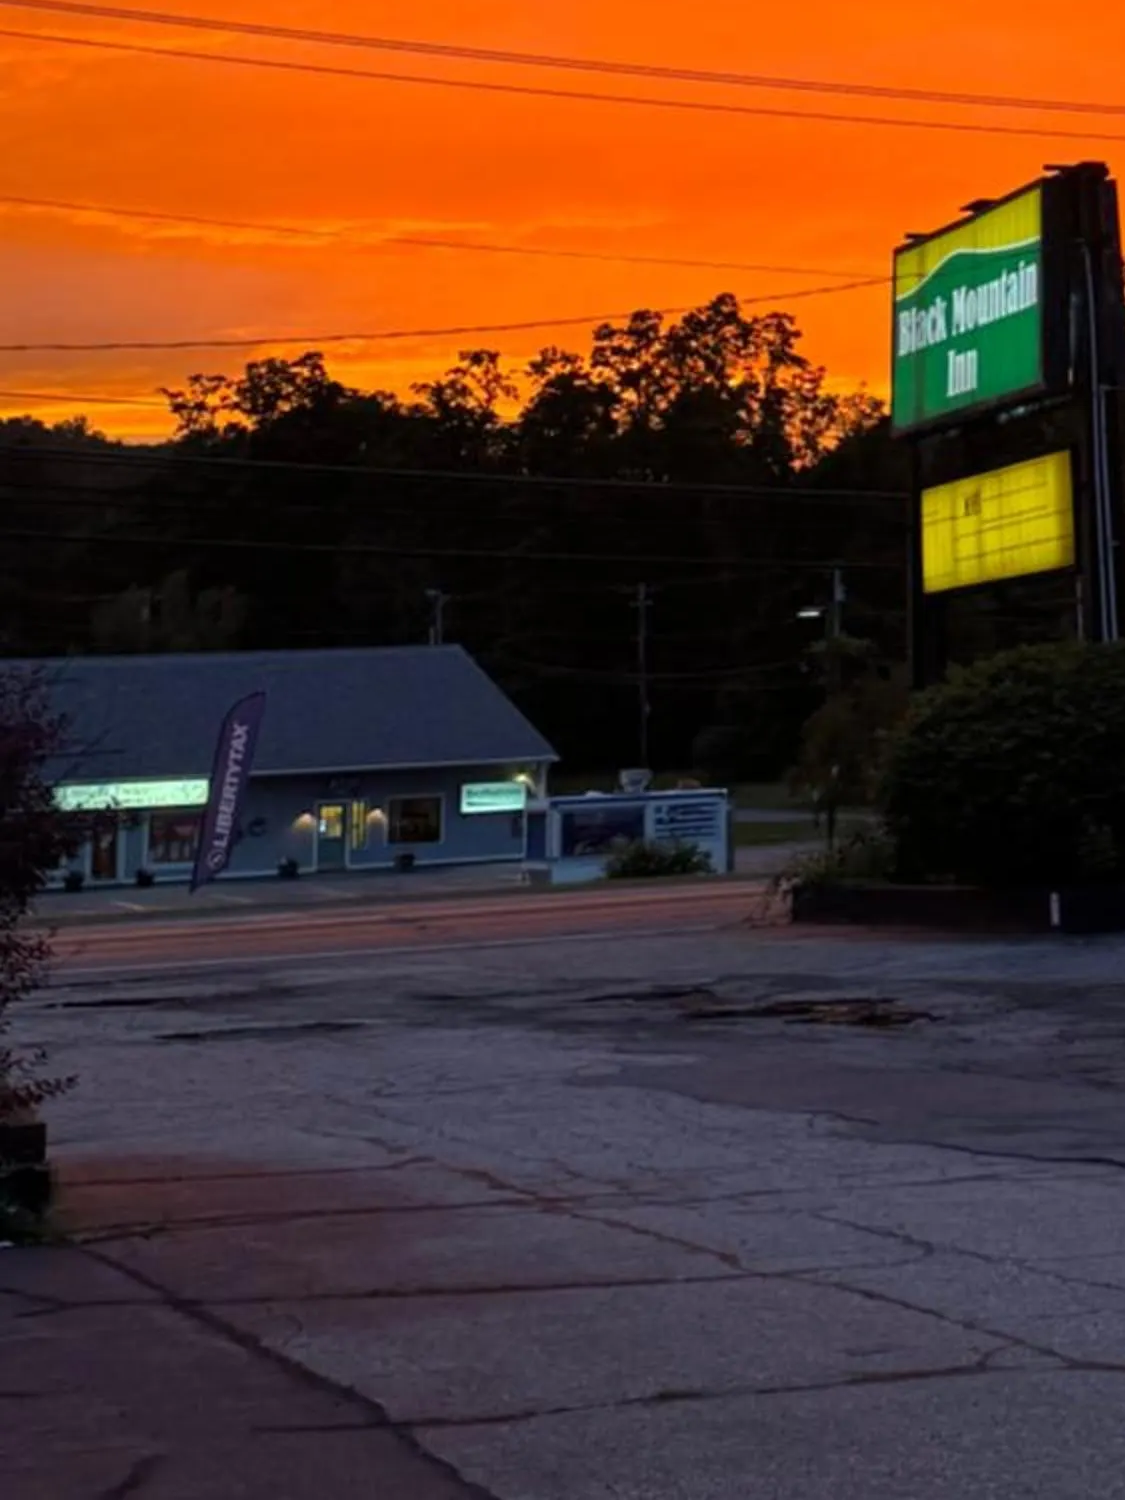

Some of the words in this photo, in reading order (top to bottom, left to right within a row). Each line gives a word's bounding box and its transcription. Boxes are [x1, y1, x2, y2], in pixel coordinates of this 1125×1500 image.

[898, 295, 948, 357] Black
[951, 260, 1038, 337] Mountain
[946, 349, 978, 397] Inn
